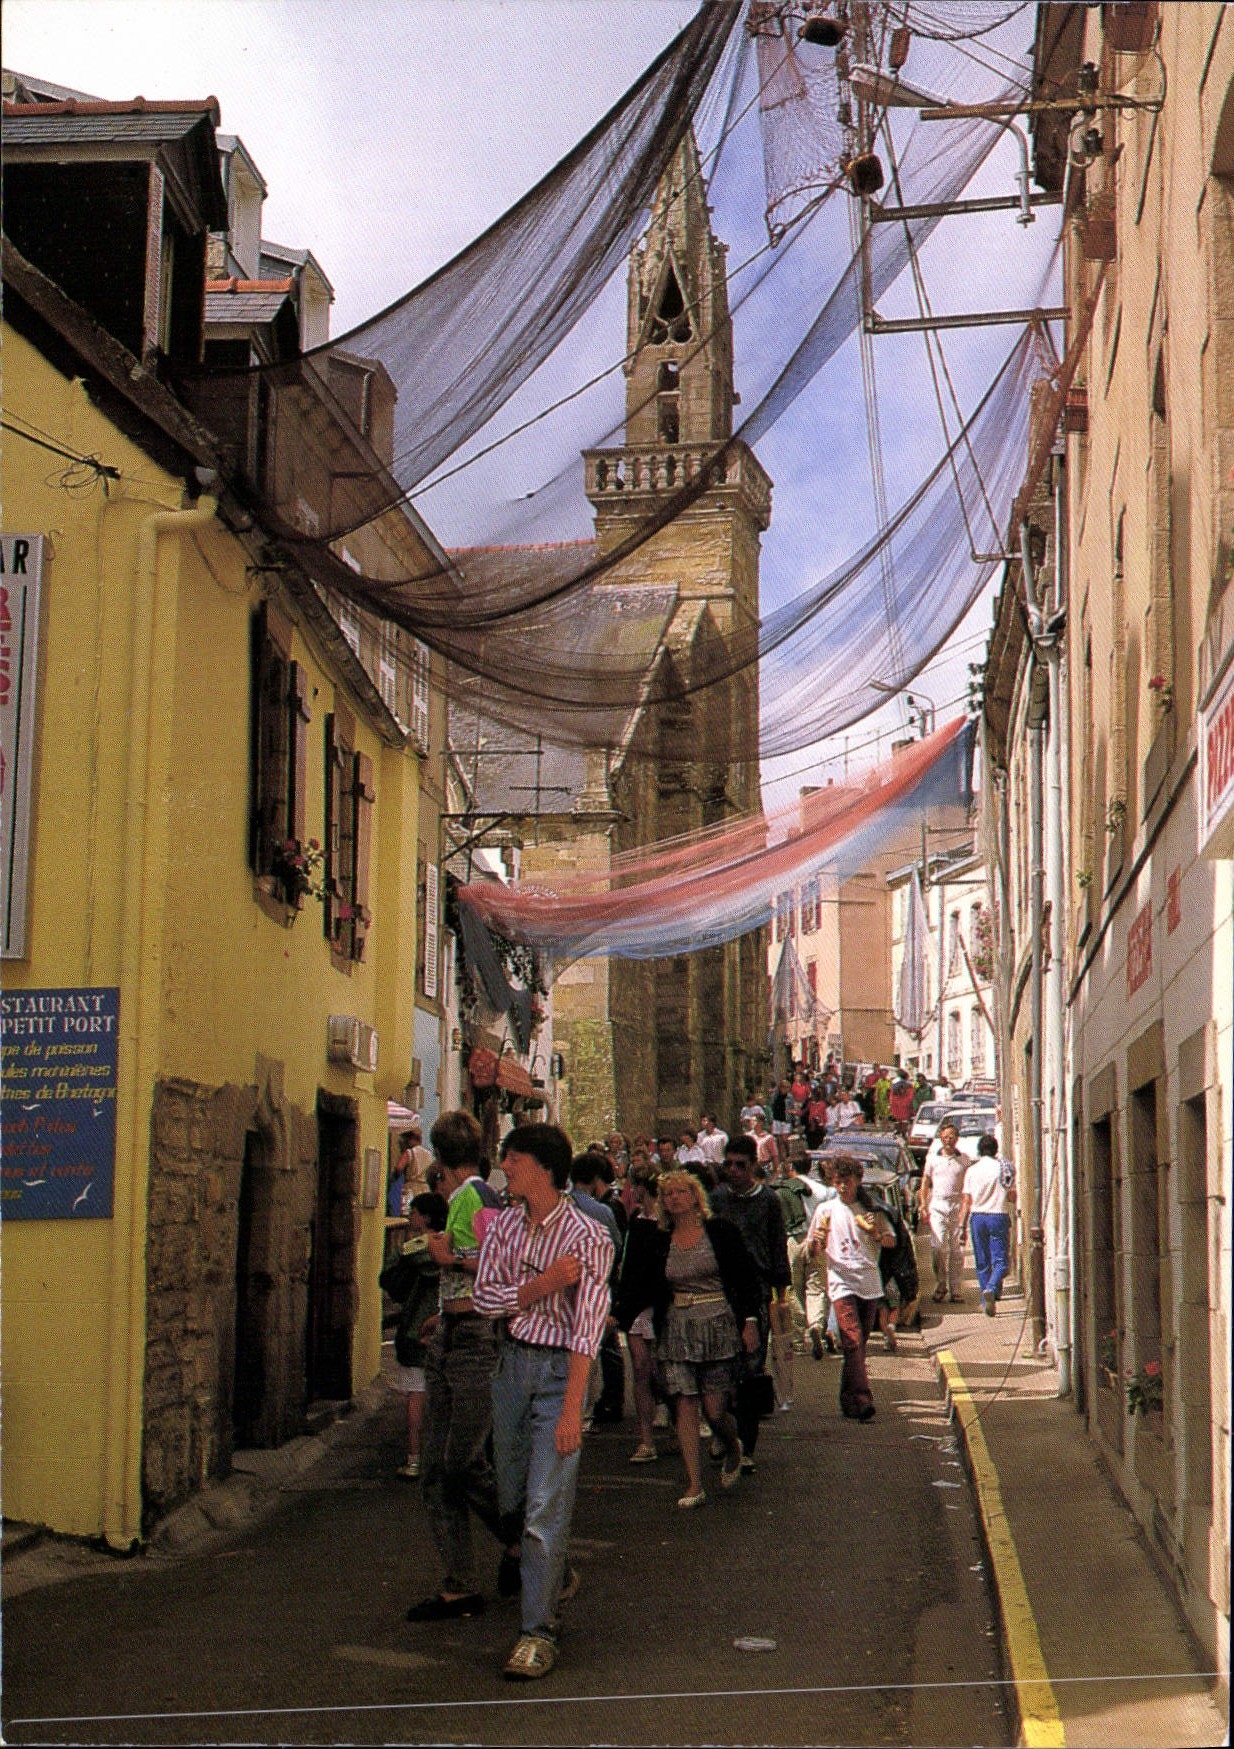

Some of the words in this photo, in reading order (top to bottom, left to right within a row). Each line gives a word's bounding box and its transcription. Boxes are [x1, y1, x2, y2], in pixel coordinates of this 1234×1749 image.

[1, 1016, 57, 1035] PETIT
[62, 1015, 116, 1033] PORT
[23, 1040, 42, 1056] de
[44, 1043, 98, 1061] poisson
